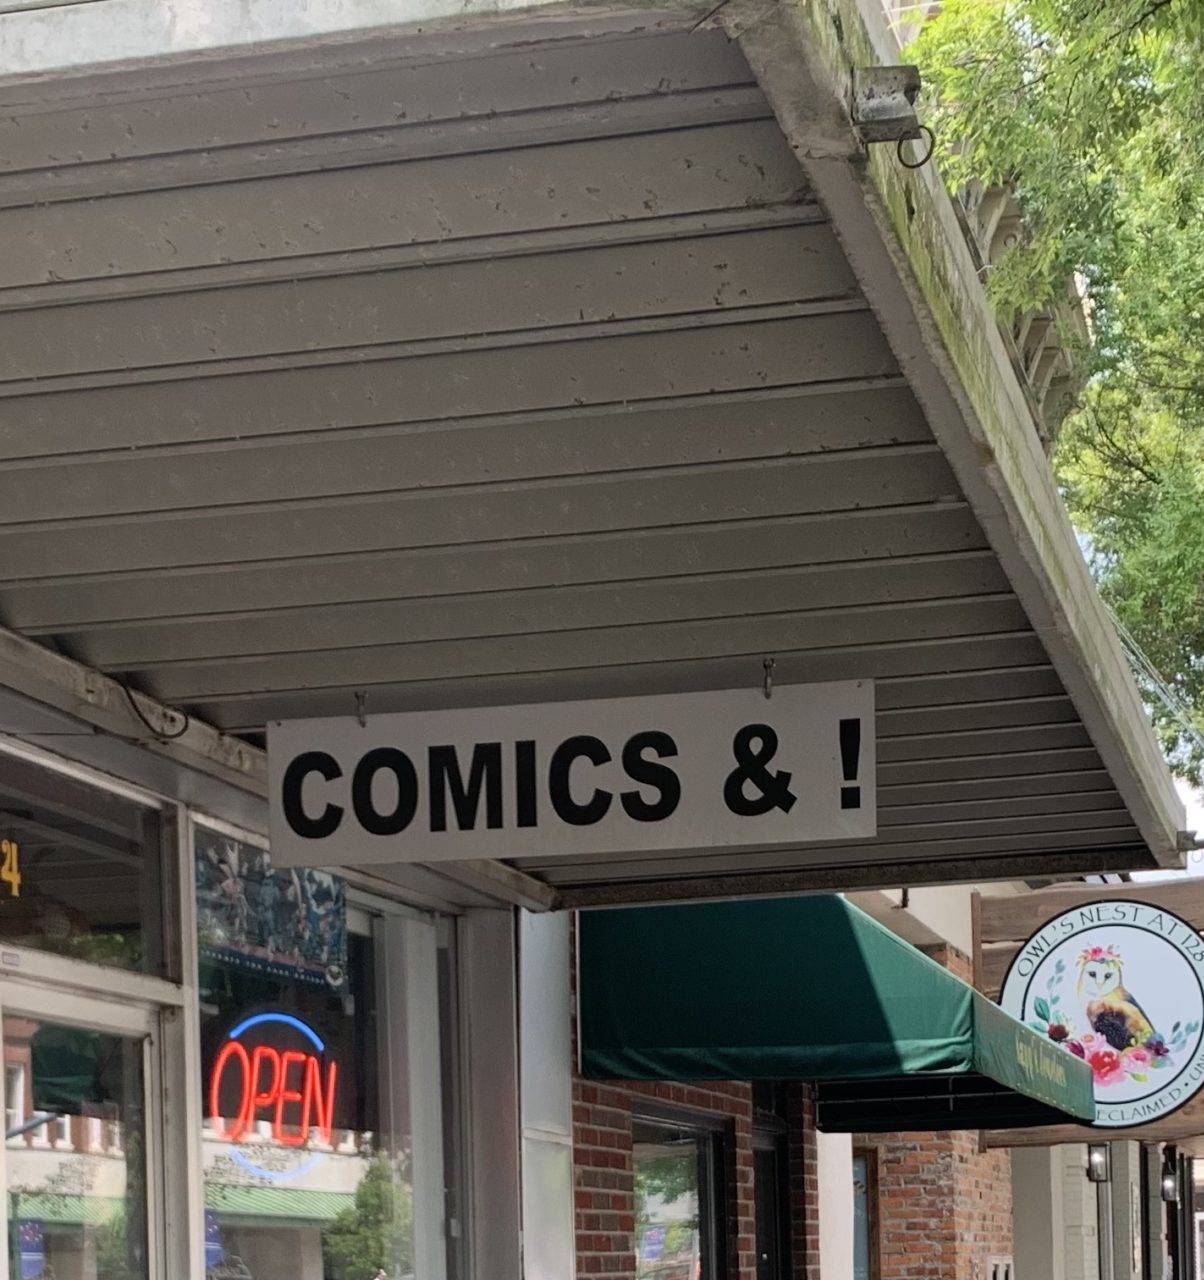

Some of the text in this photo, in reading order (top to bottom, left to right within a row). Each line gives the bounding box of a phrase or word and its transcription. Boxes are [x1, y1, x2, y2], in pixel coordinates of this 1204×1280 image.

[282, 717, 861, 840] COMICS & !
[1017, 917, 1074, 977] OWL'S
[1080, 905, 1146, 923] NEST
[1149, 913, 1184, 935] AT
[210, 1041, 337, 1146] OPEN
[1096, 1087, 1182, 1122] ECLAIMED
